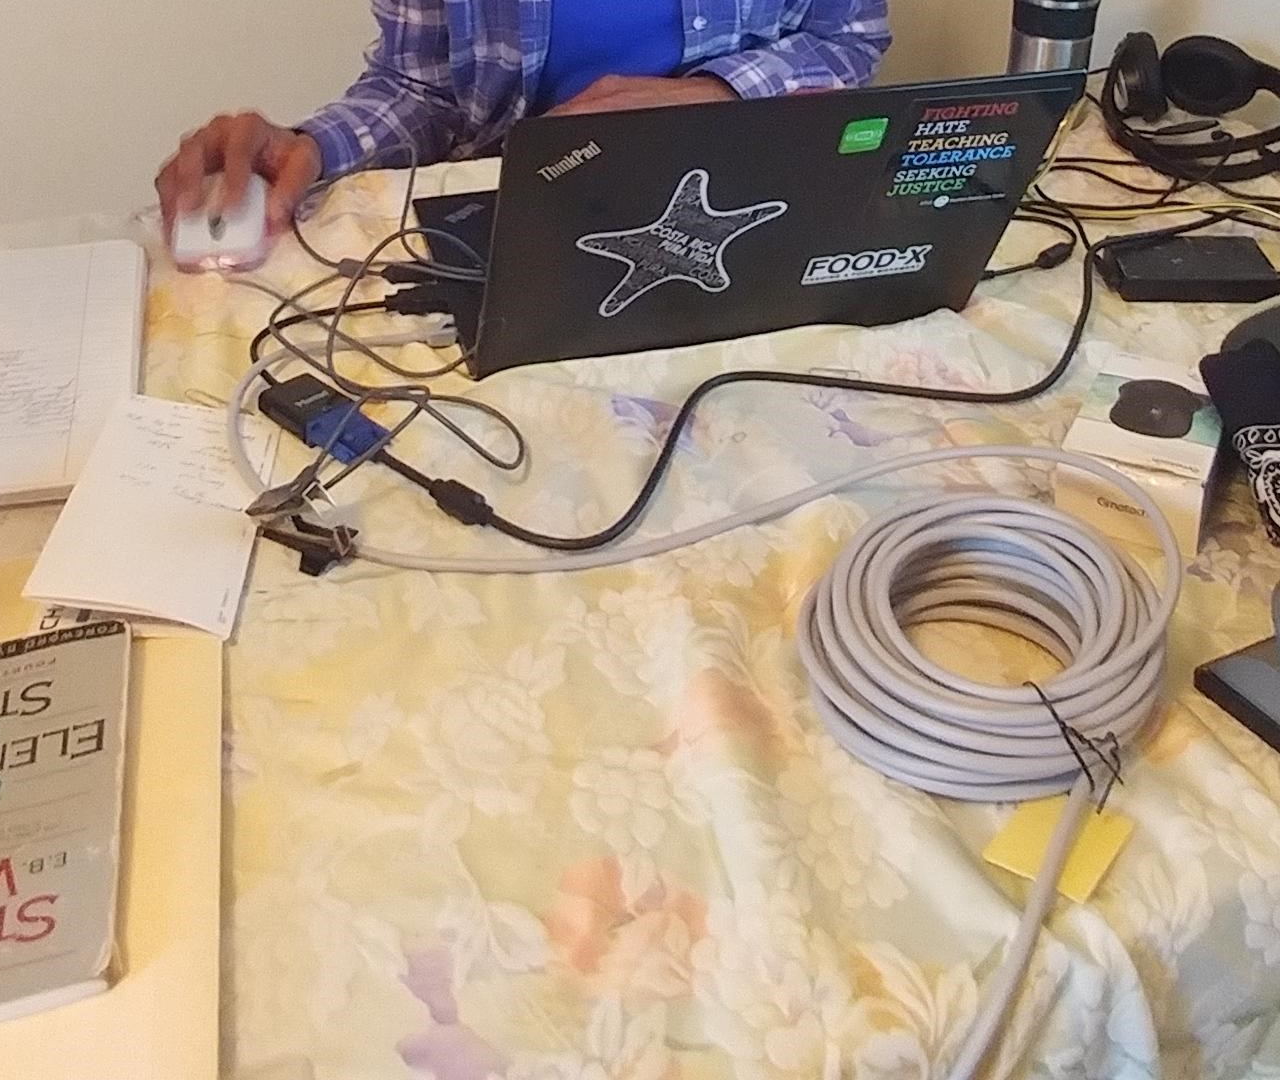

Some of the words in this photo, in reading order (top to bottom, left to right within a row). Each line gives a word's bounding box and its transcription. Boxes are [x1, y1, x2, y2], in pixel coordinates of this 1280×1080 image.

[922, 102, 1019, 121] FIGHTING
[914, 120, 970, 137] HATE
[907, 132, 1009, 153] TEACHING
[537, 140, 602, 182] ThinkPad
[901, 145, 1017, 167] TOLERANCE
[893, 164, 977, 183] SEEKING
[886, 178, 967, 197] JUSTICE
[650, 226, 690, 246] COSTA
[688, 237, 718, 256] RICA
[657, 239, 688, 257] PURA
[687, 249, 715, 267] VIDA
[807, 248, 928, 277] FOOD-X
[22, 621, 121, 653] FOREWORD
[22, 852, 68, 875] E.B.
